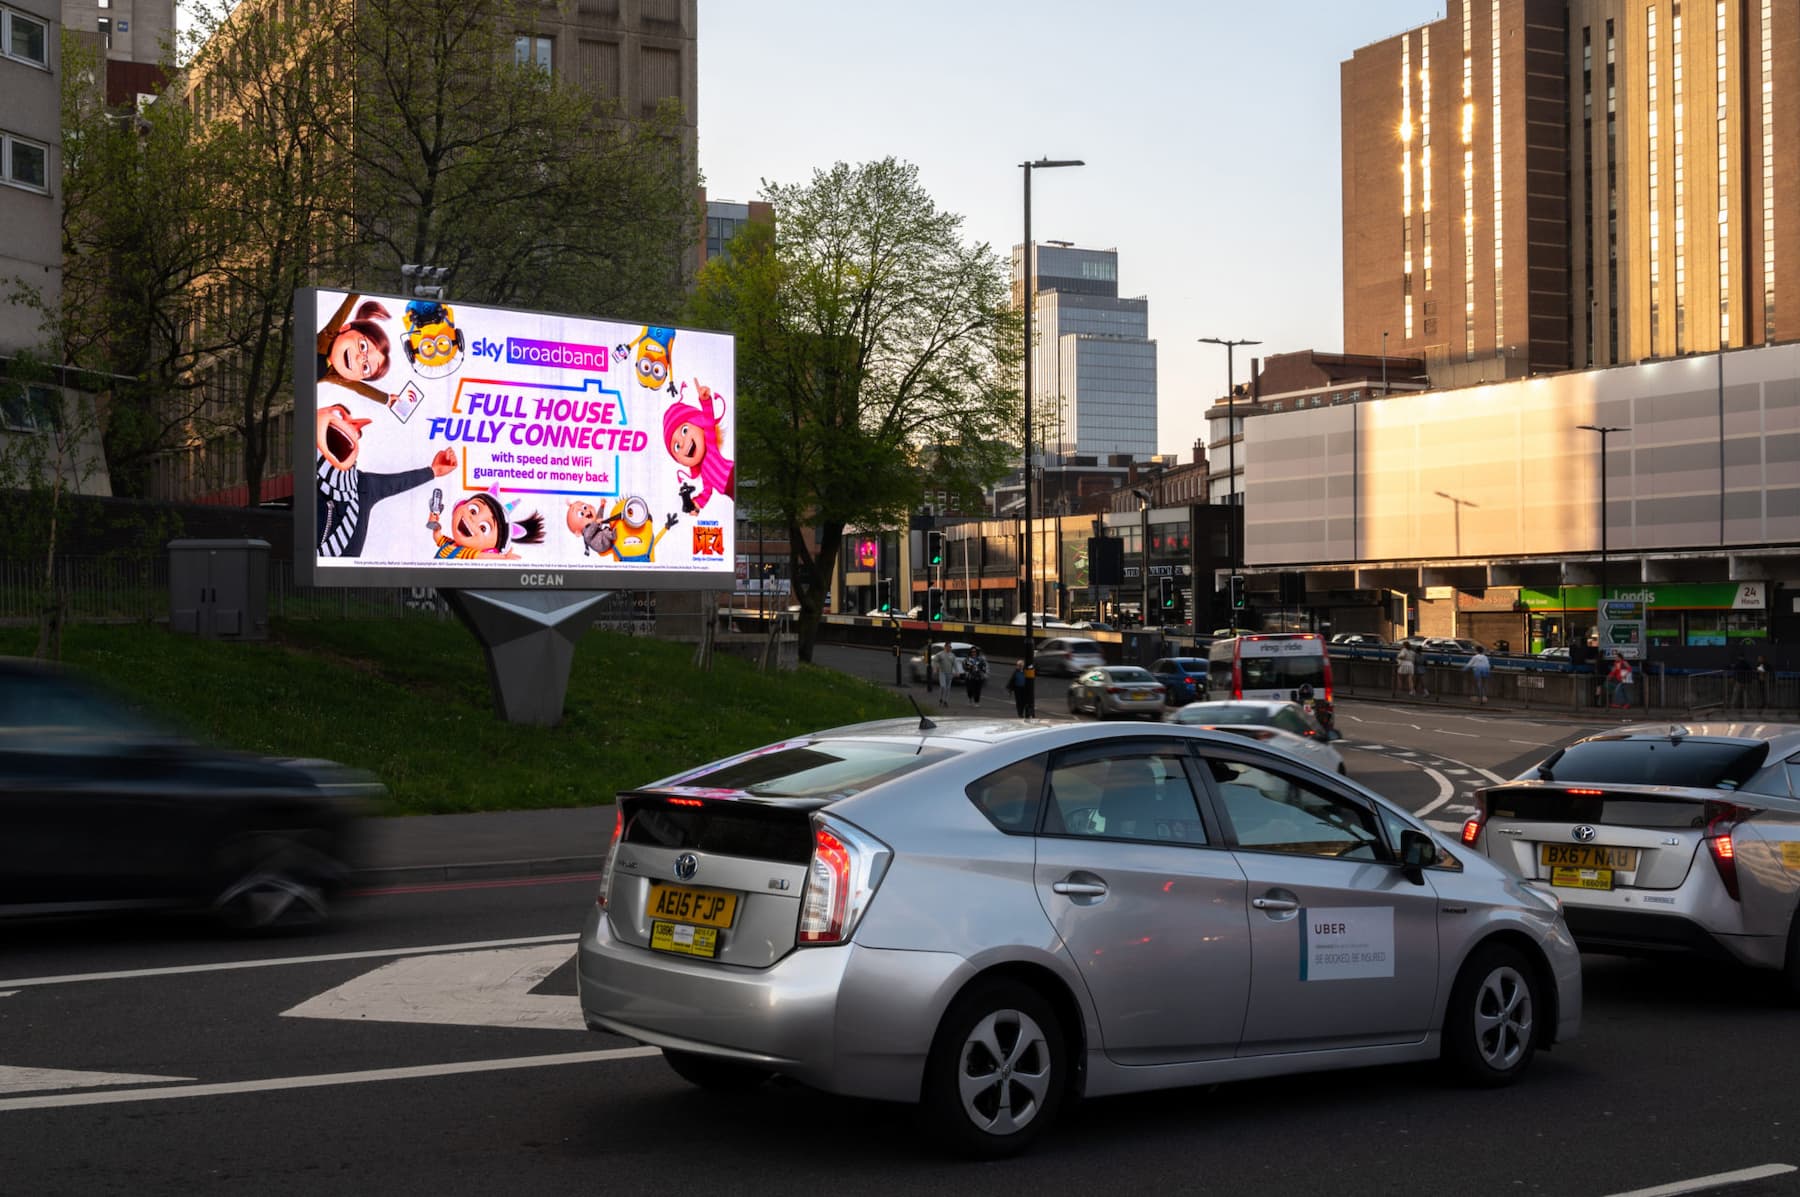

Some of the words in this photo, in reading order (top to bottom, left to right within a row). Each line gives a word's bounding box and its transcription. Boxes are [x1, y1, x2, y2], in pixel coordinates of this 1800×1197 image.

[472, 337, 503, 362] sky
[510, 341, 605, 367] broadband
[465, 393, 527, 418] FULL
[532, 397, 616, 424] HOUSE
[427, 417, 506, 443] FULLY
[510, 422, 648, 452] CONNECTED
[491, 451, 515, 463] with
[516, 454, 547, 467] speed
[550, 455, 570, 466] and
[571, 456, 593, 467] WiFi
[473, 466, 535, 480] guaranteed
[536, 470, 548, 480] or
[550, 471, 583, 484] money
[585, 471, 609, 483] back
[520, 574, 564, 586] OCEAN
[1614, 588, 1655, 603] Londis
[1744, 586, 1757, 597] 24
[1548, 847, 1591, 865] BX67
[656, 890, 692, 916] AE15
[692, 894, 726, 920] FJP
[1314, 923, 1346, 934] UBER
